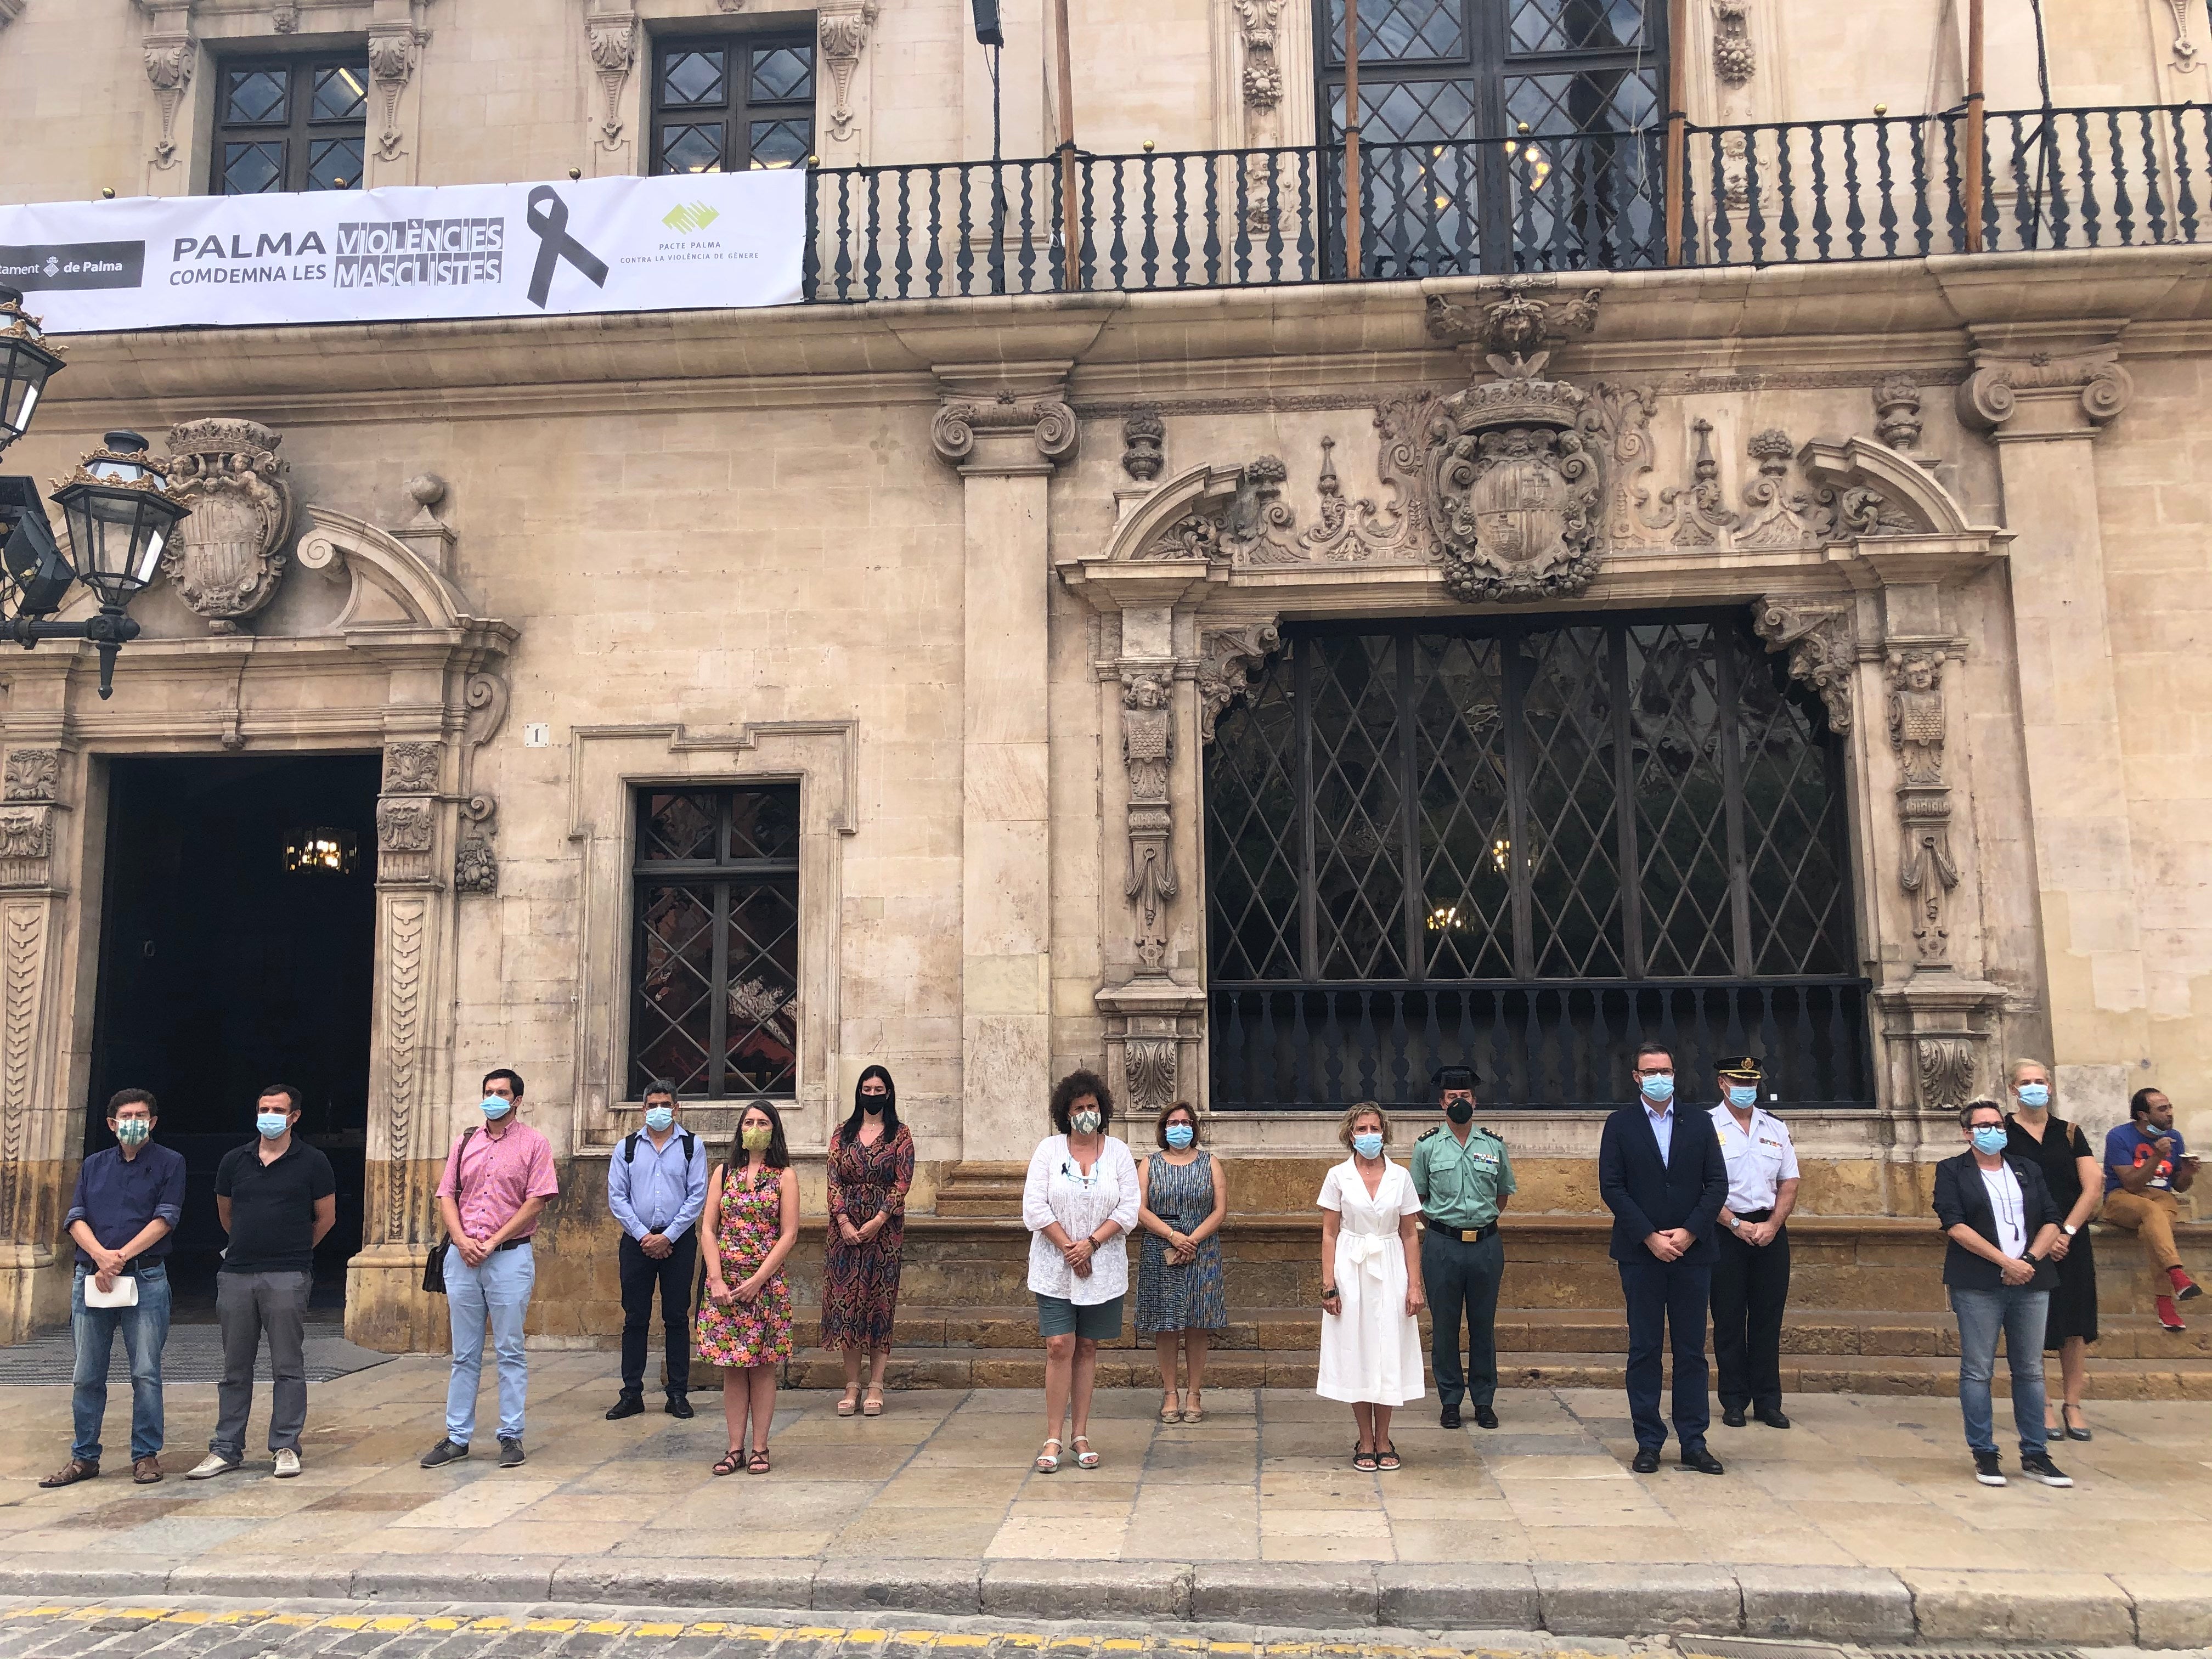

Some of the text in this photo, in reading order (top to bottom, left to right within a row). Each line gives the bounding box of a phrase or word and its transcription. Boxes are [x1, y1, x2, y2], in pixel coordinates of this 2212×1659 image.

[173, 231, 327, 262] PALMA
[337, 217, 504, 254] VIOLÈNCIES
[63, 262, 80, 273] de
[83, 260, 122, 272] Palma
[668, 252, 710, 261] VIOLÈNCIA
[169, 264, 326, 286] COMDEMNA LES
[334, 251, 502, 288] MASCLISTES
[535, 729, 539, 742] 1
